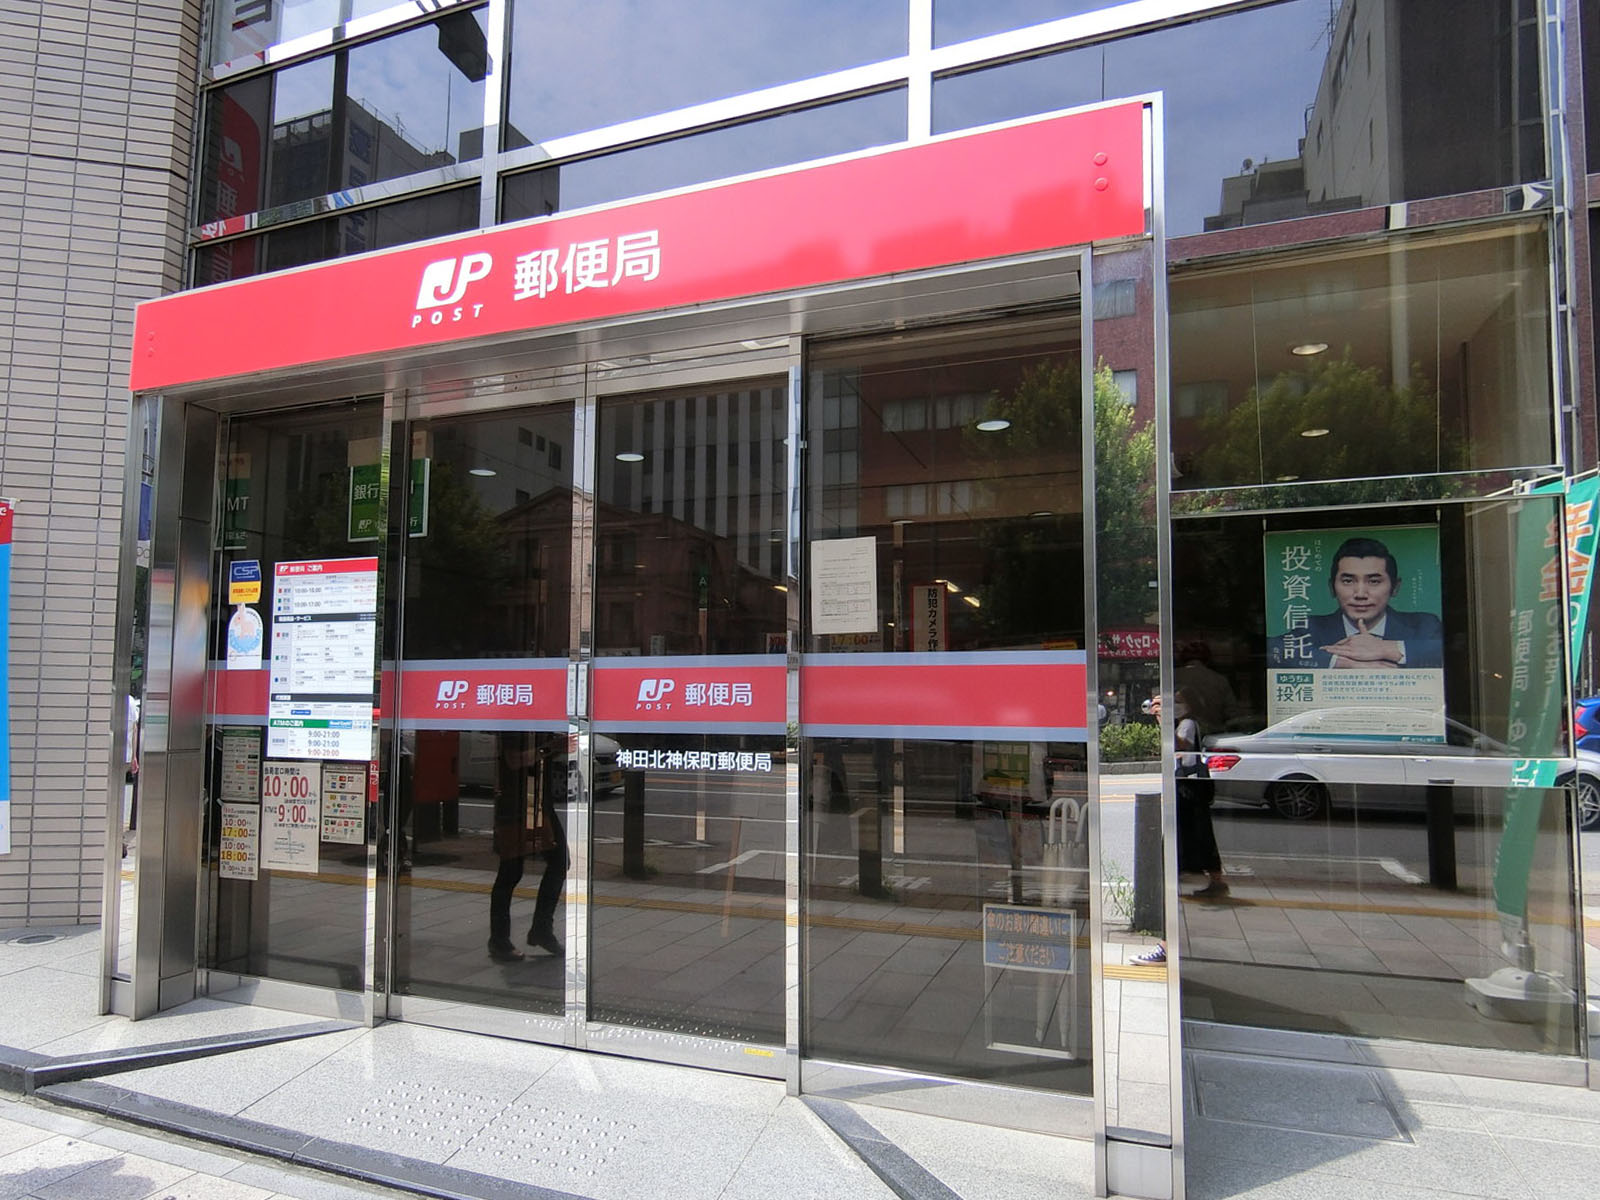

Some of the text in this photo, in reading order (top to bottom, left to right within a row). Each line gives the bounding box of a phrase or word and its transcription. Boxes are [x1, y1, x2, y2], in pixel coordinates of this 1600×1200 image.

[513, 229, 661, 301] 郵便局
[411, 303, 484, 328] POST
[233, 565, 259, 576] CSP
[1281, 546, 1313, 660] 投資信託
[928, 588, 938, 651] 防犯カメラ作
[1279, 675, 1311, 683] ゆうちょ
[476, 684, 533, 706] 郵便局
[685, 683, 753, 707] 郵便局
[1276, 686, 1314, 702] 投信
[635, 702, 672, 710] POST
[615, 749, 772, 772] 神田北神保町郵便局
[264, 776, 309, 798] 10:00
[225, 818, 247, 827] 10:00
[278, 804, 306, 823] 9:00
[222, 827, 249, 838] 17:00
[224, 842, 245, 850] 10:00
[221, 850, 248, 862] 18:00
